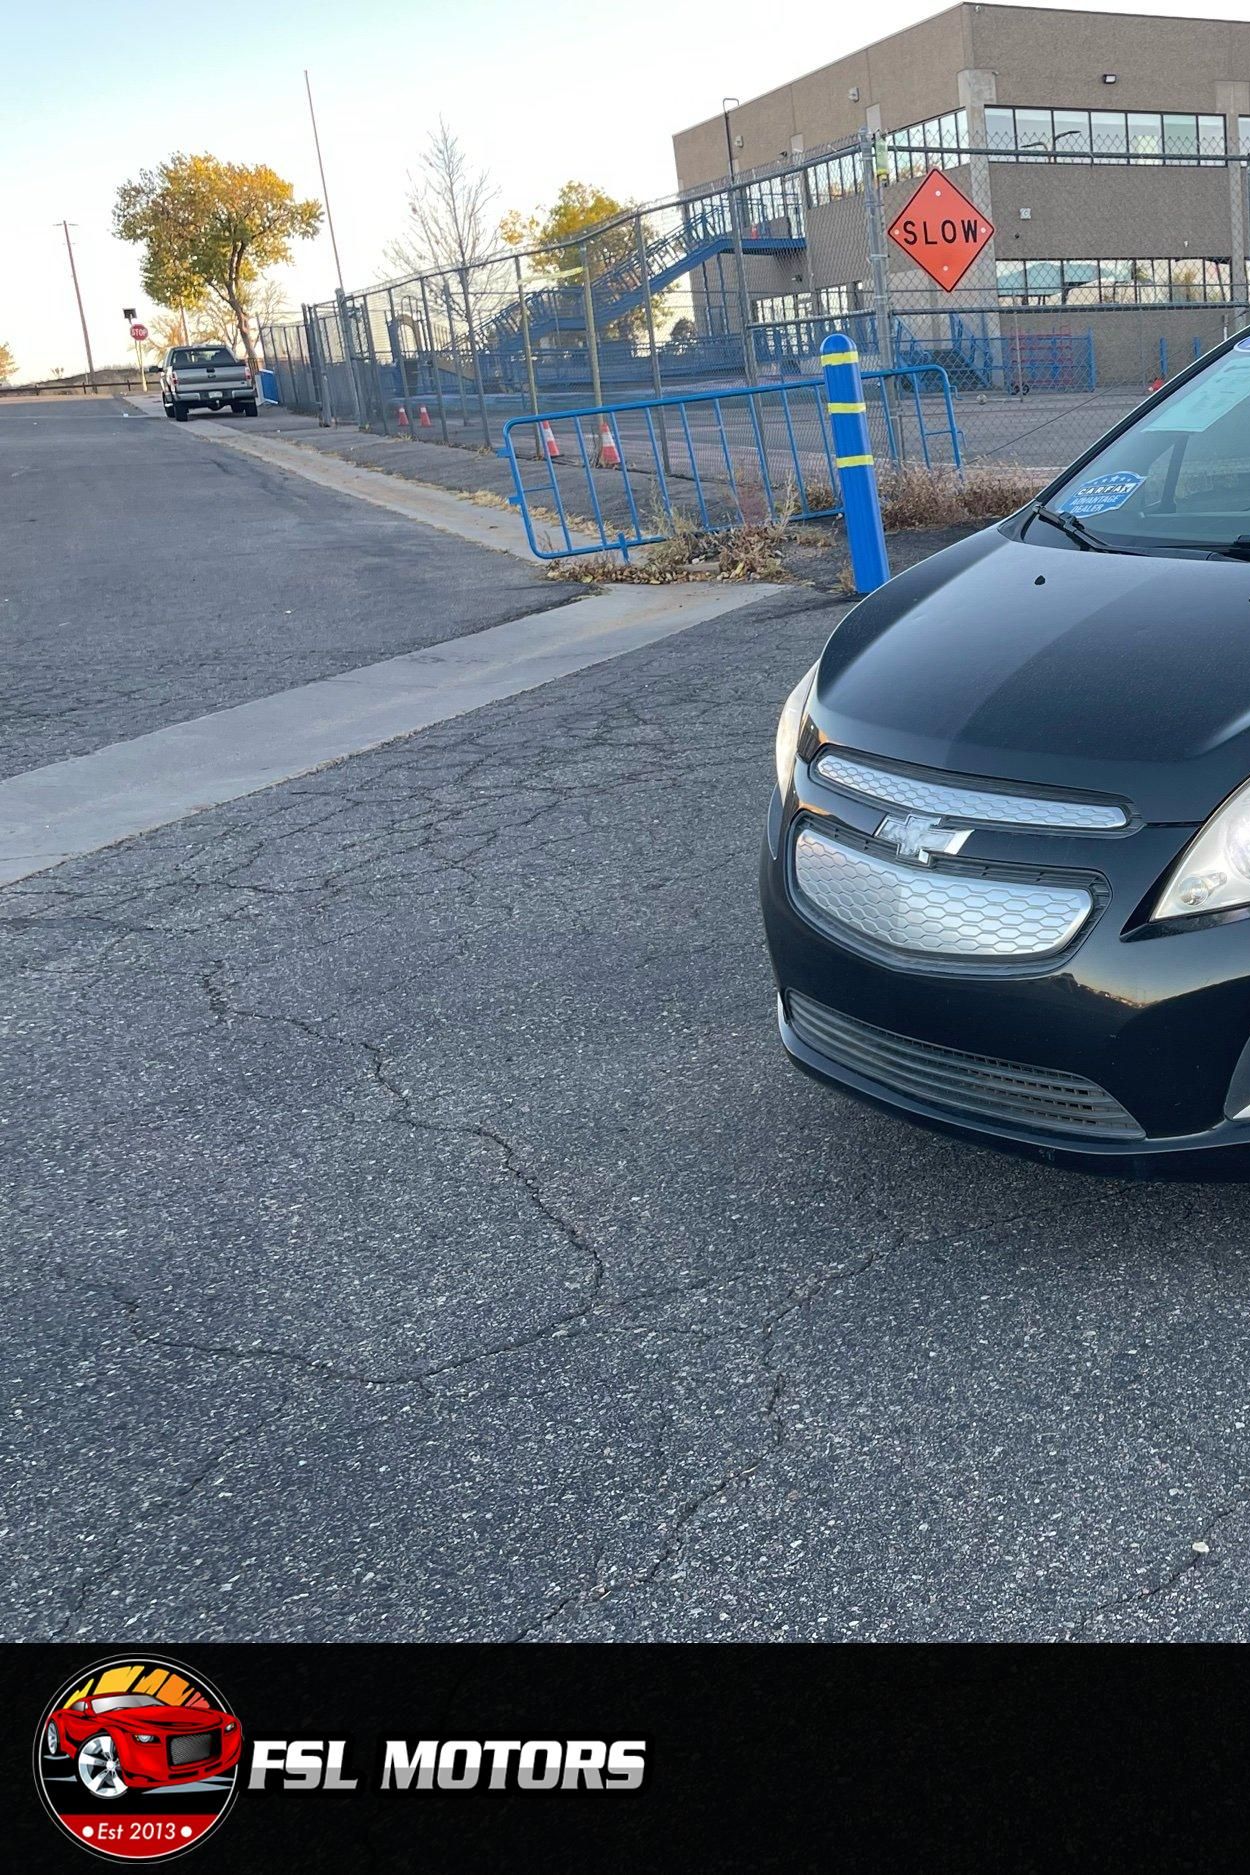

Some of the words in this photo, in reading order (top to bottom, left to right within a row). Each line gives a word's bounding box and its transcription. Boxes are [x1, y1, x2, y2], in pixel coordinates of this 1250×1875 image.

[903, 219, 978, 246] SLOW
[131, 329, 146, 337] STOP
[1077, 483, 1136, 495] CARFAX
[1069, 495, 1119, 505] ADVANTAGE
[1070, 504, 1104, 513] DEALER
